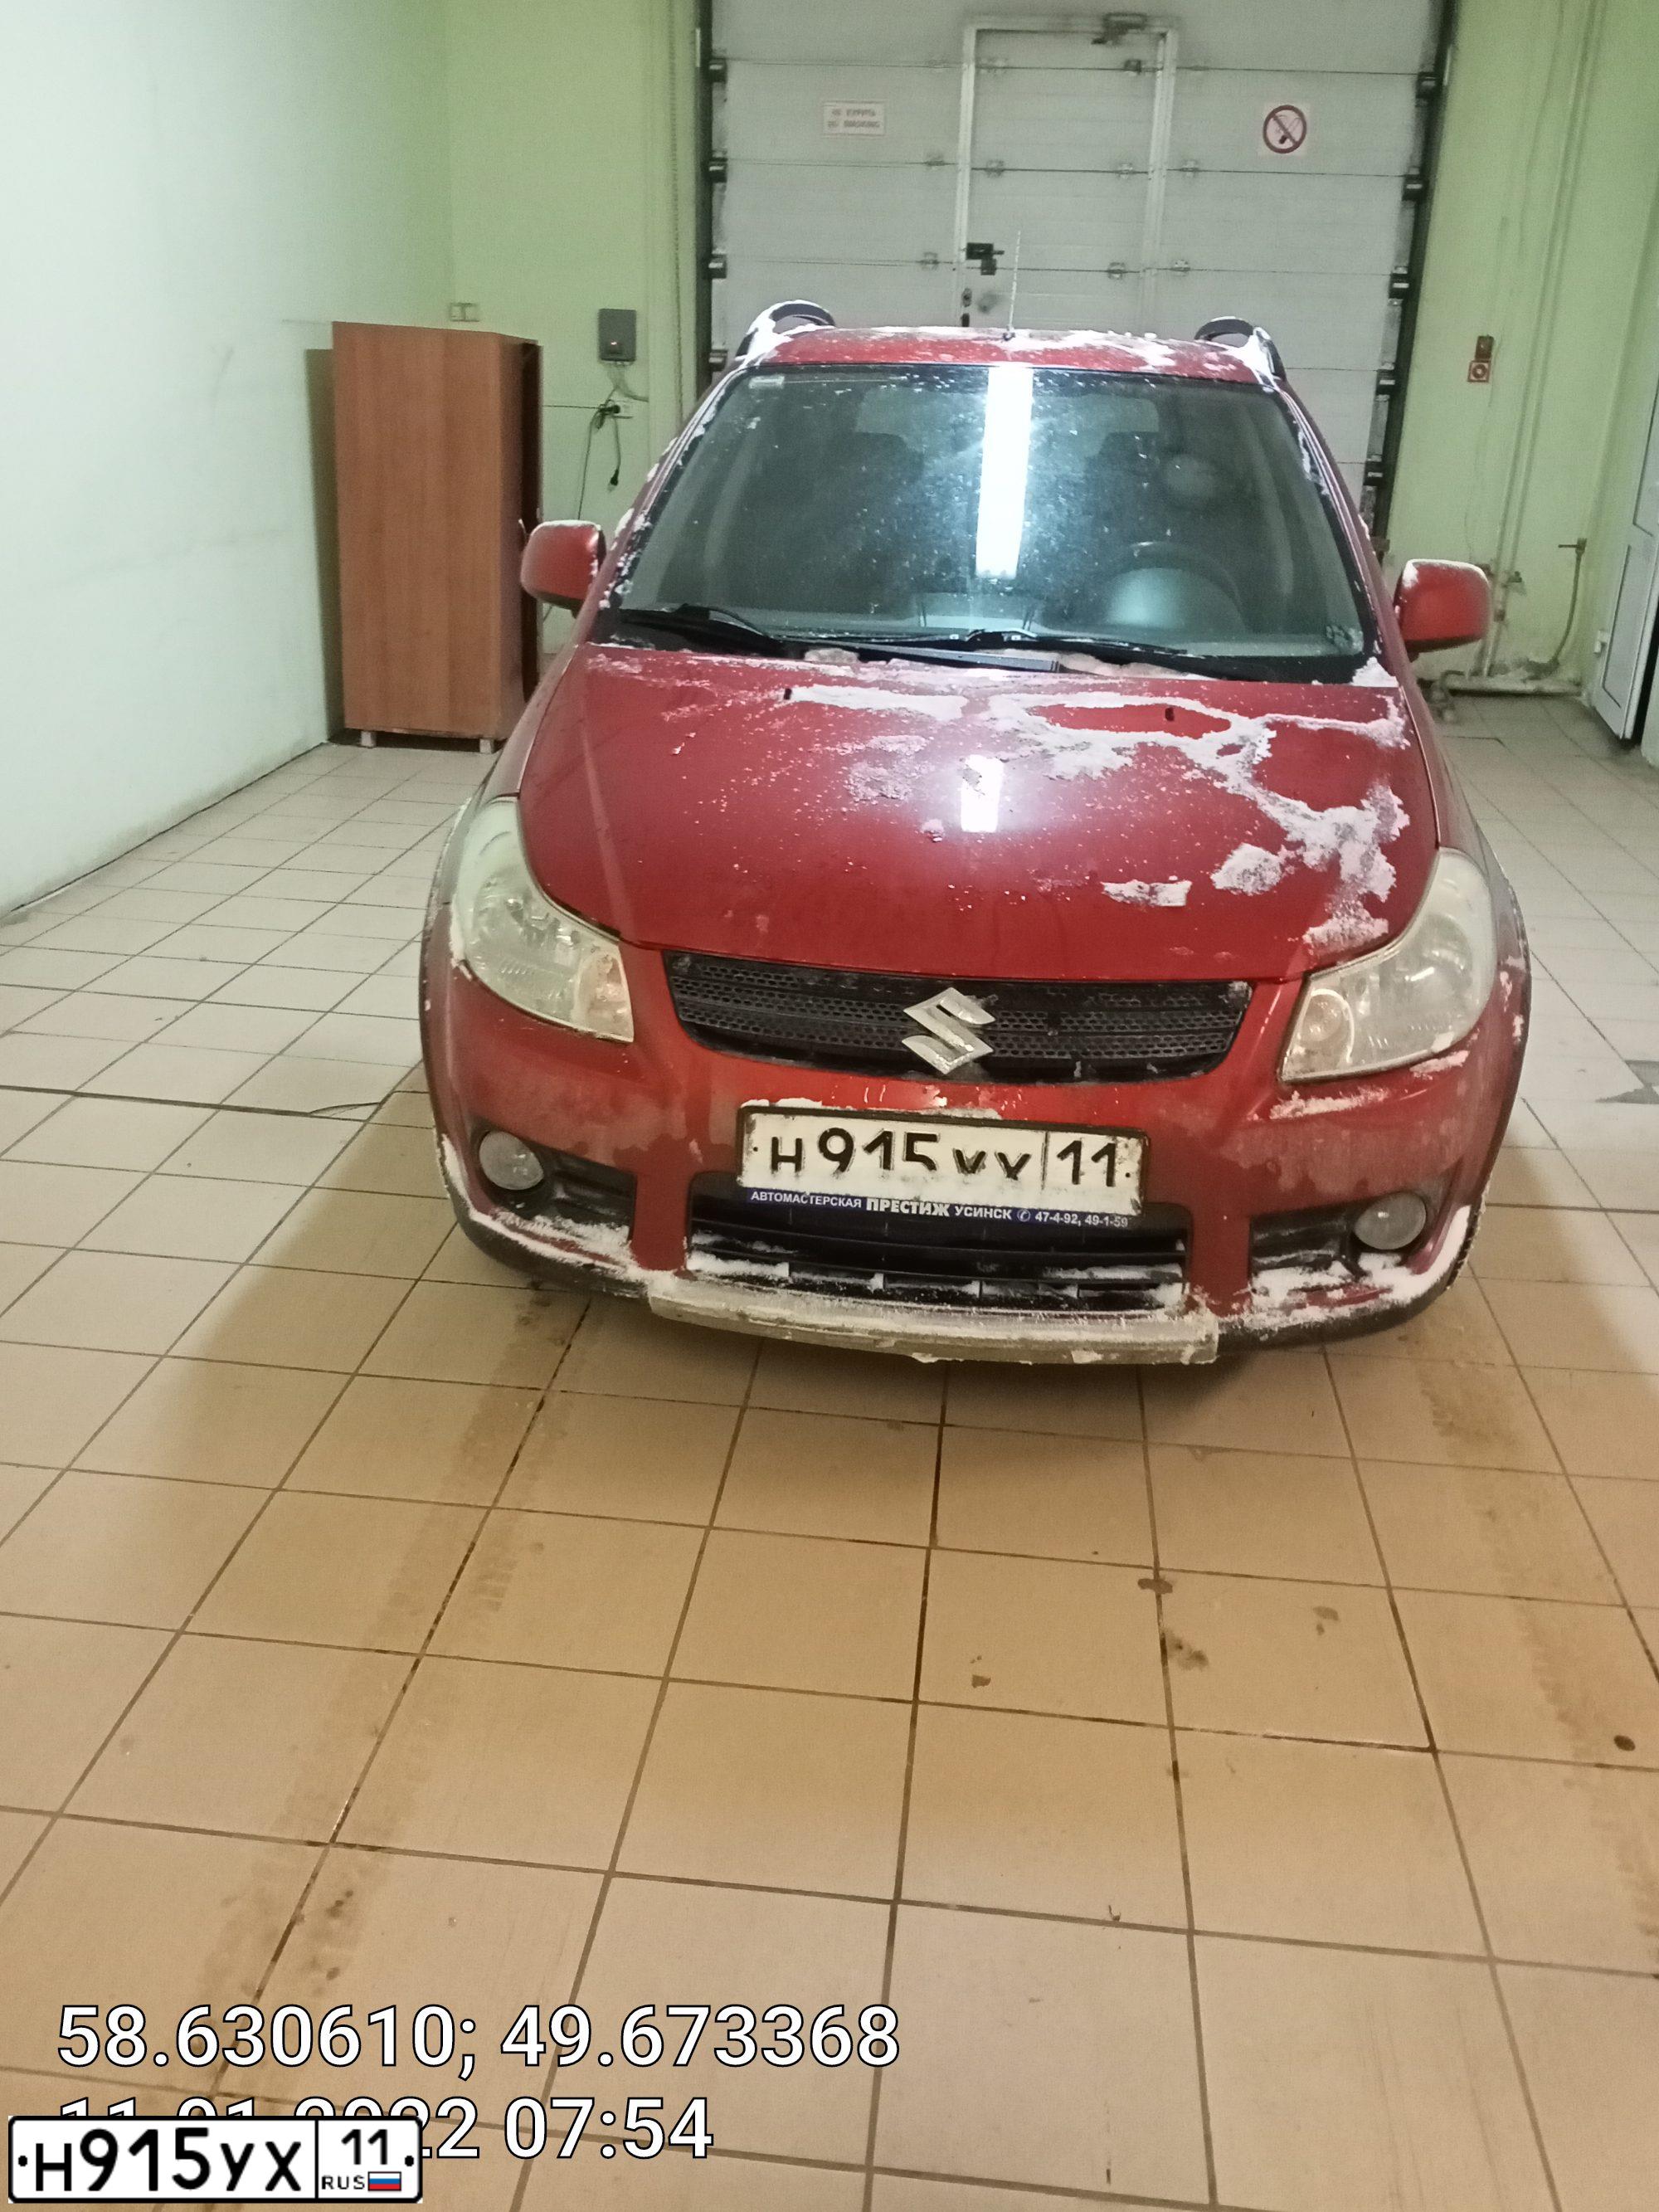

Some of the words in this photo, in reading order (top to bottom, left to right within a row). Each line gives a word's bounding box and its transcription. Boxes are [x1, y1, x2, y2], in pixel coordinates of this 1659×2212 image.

[1056, 1140, 1117, 1187] 11
[751, 1191, 862, 1209] АВТОМАСТЕРСКАЯ
[865, 1197, 951, 1217] ПРЕСТИЖ
[955, 1205, 1013, 1220] УСИНСК
[1034, 1211, 1082, 1227] 47-4-92,
